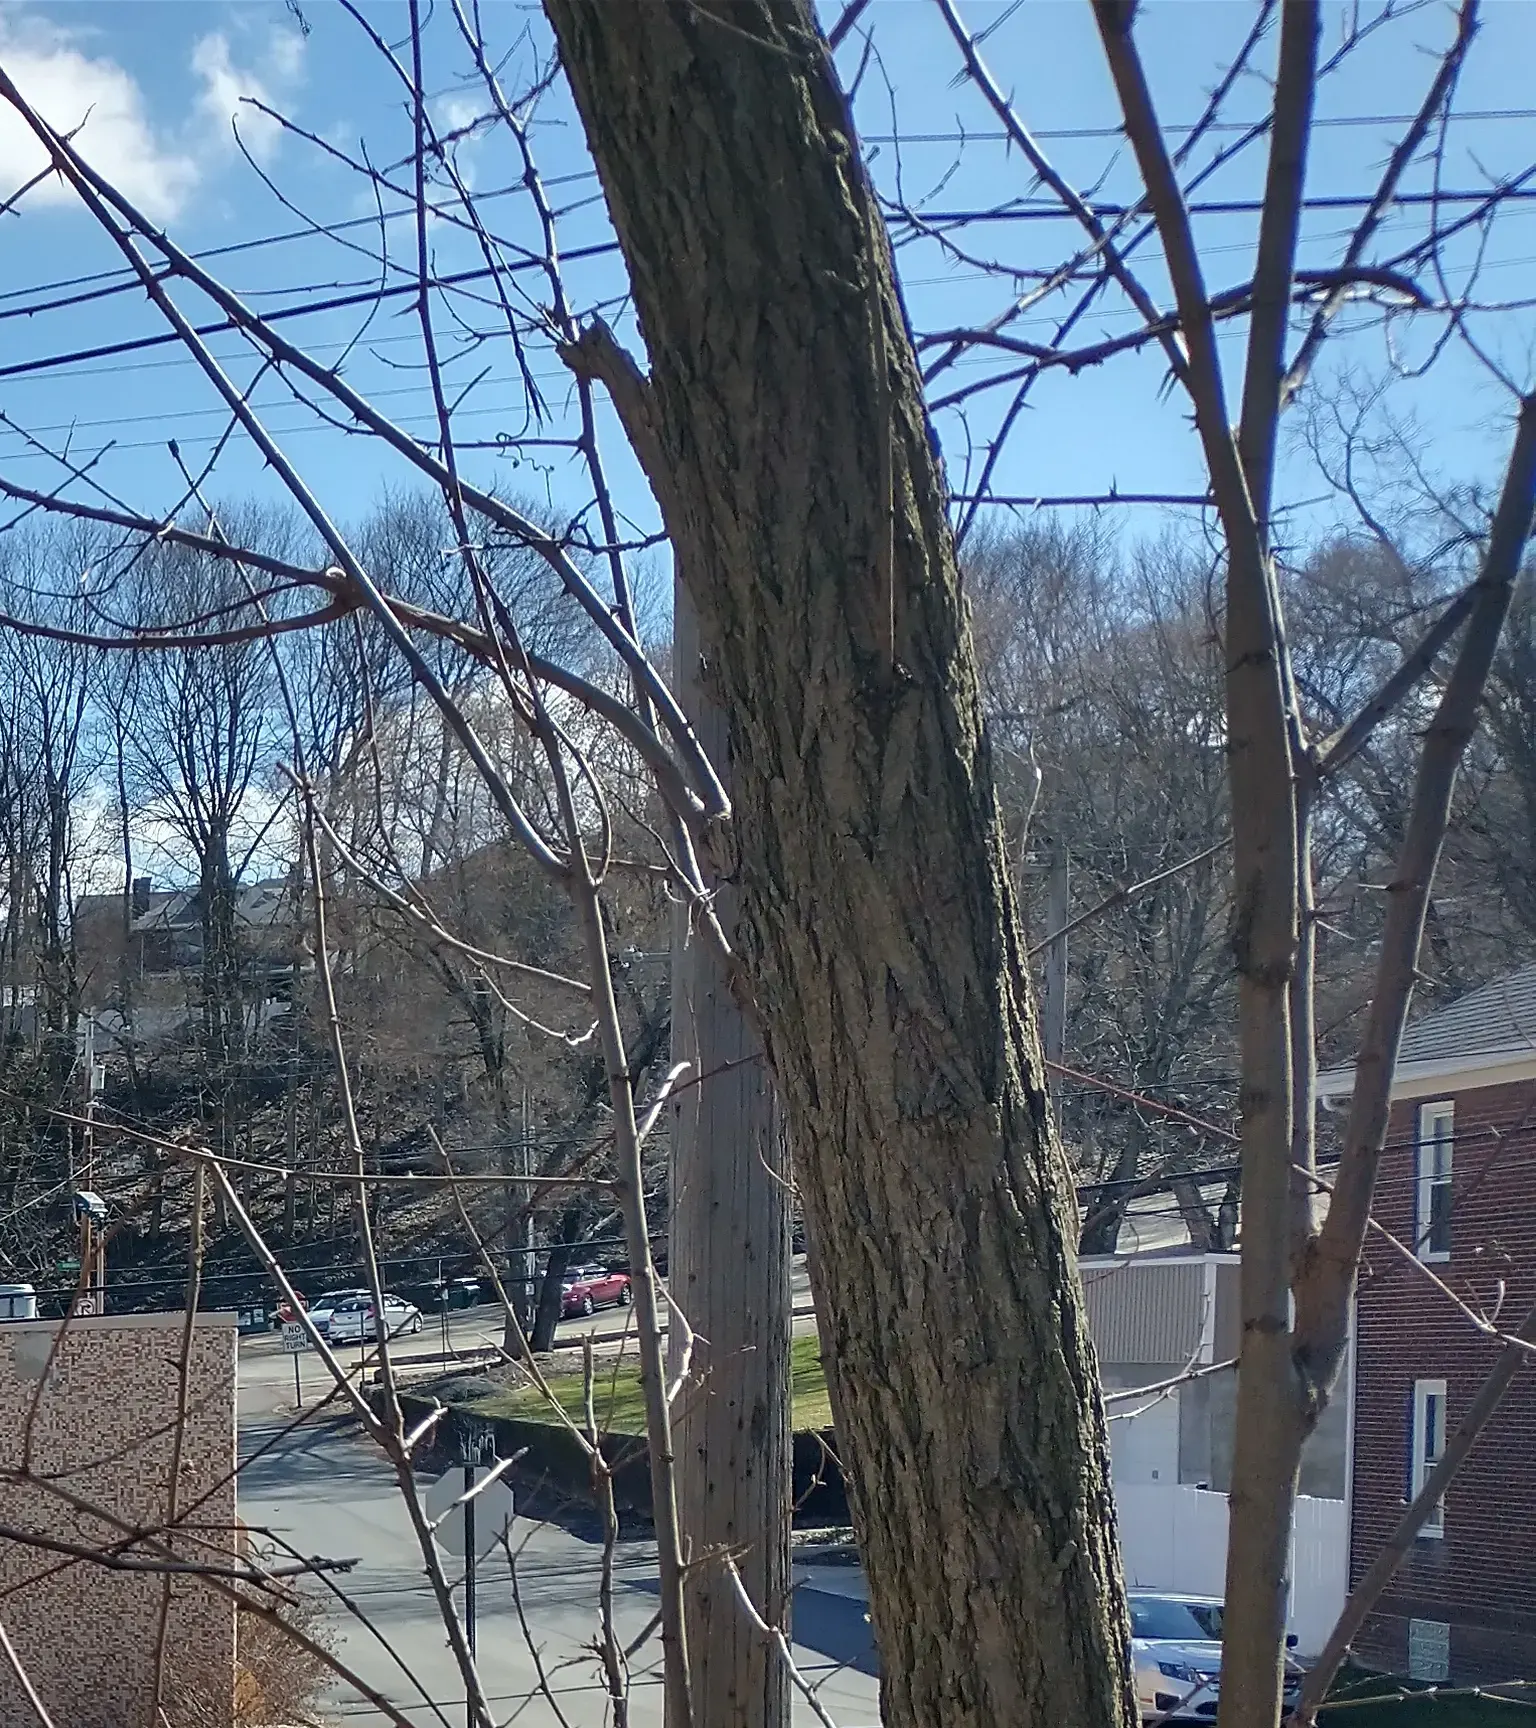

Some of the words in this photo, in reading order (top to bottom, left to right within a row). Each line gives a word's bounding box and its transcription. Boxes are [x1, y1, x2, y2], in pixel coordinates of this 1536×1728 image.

[288, 1325, 301, 1333] NO
[284, 1333, 307, 1342] RIGHT
[285, 1341, 306, 1350] TURN
